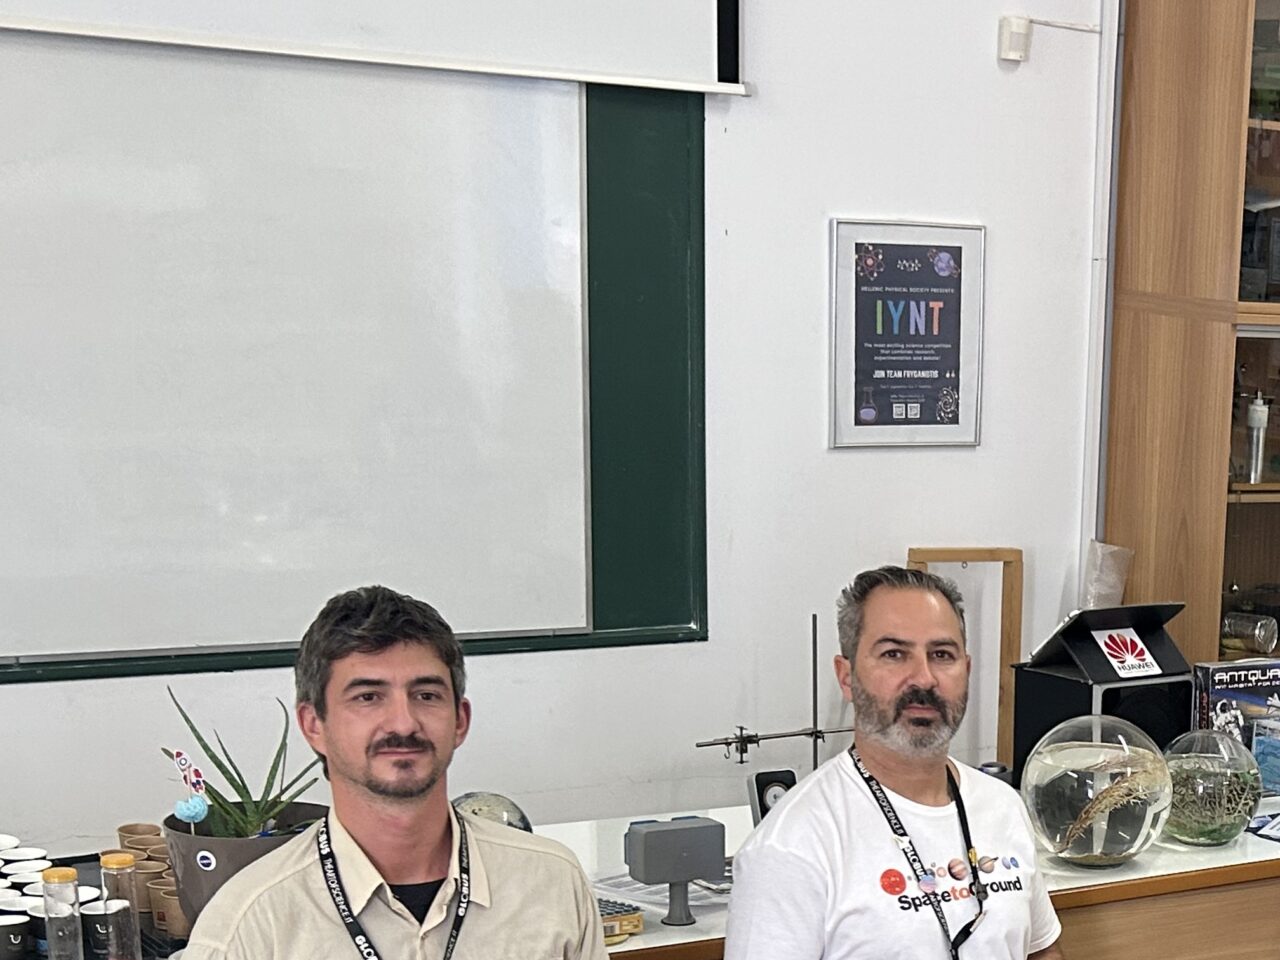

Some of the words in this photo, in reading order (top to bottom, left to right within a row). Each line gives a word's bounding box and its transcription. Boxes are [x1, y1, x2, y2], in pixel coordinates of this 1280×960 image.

[876, 299, 944, 336] IYNT
[886, 370, 902, 378] TEAM
[1117, 661, 1155, 672] HUAWEI
[458, 873, 470, 917] GLOBUS
